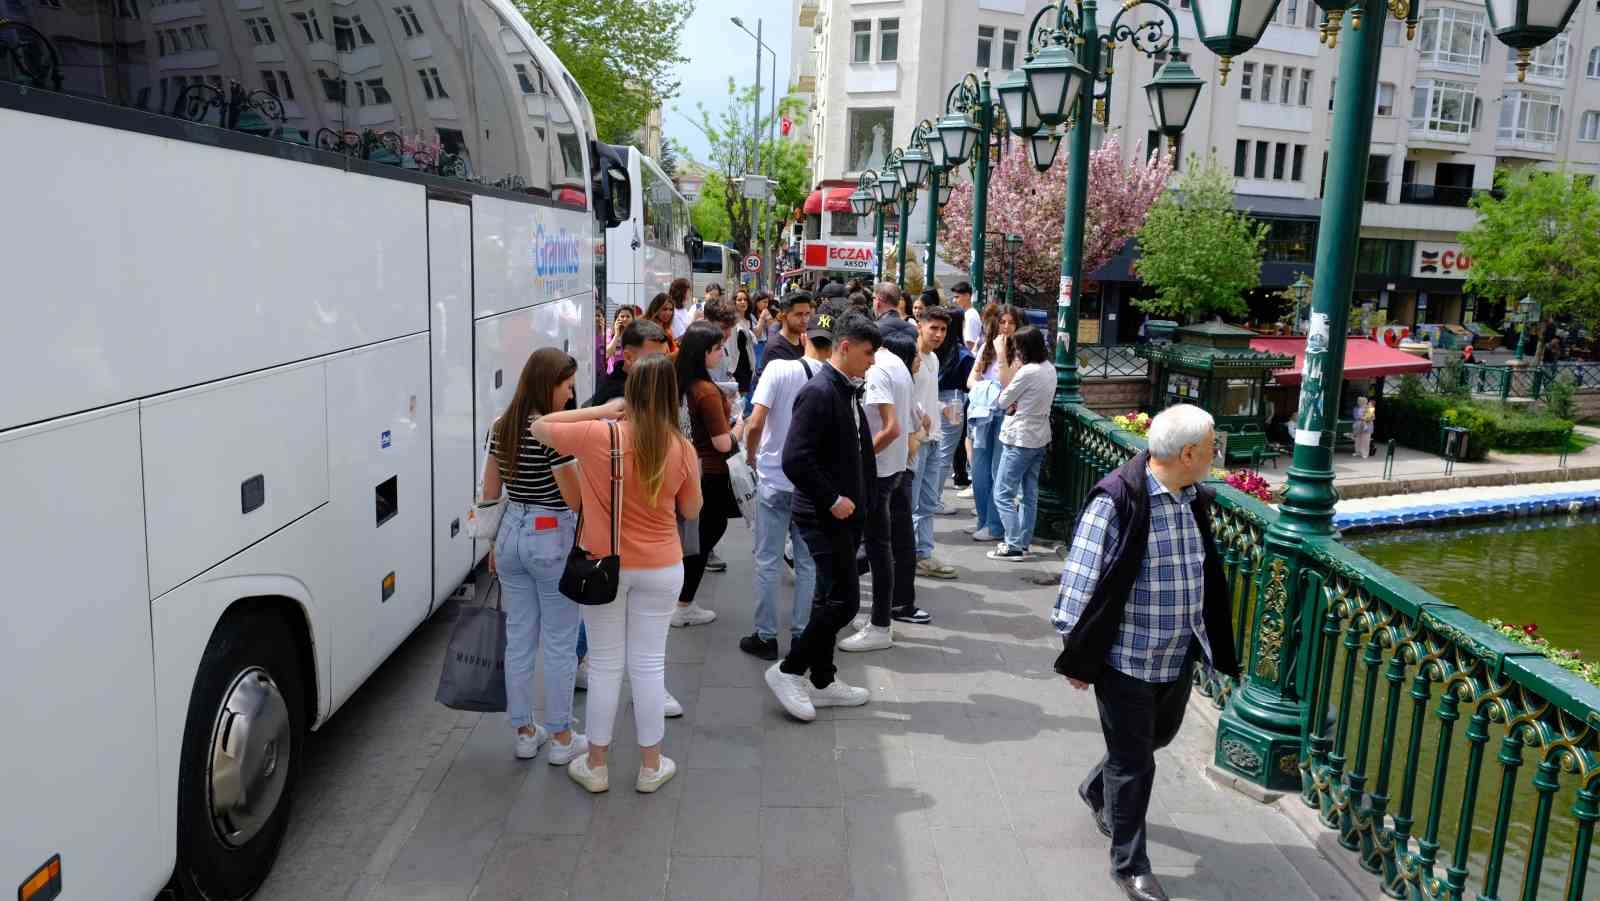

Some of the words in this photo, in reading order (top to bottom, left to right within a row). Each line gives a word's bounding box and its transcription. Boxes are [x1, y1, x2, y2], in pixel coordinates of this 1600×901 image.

[536, 224, 580, 276] Granikos
[748, 258, 759, 268] 50
[843, 260, 868, 268] AKSOY
